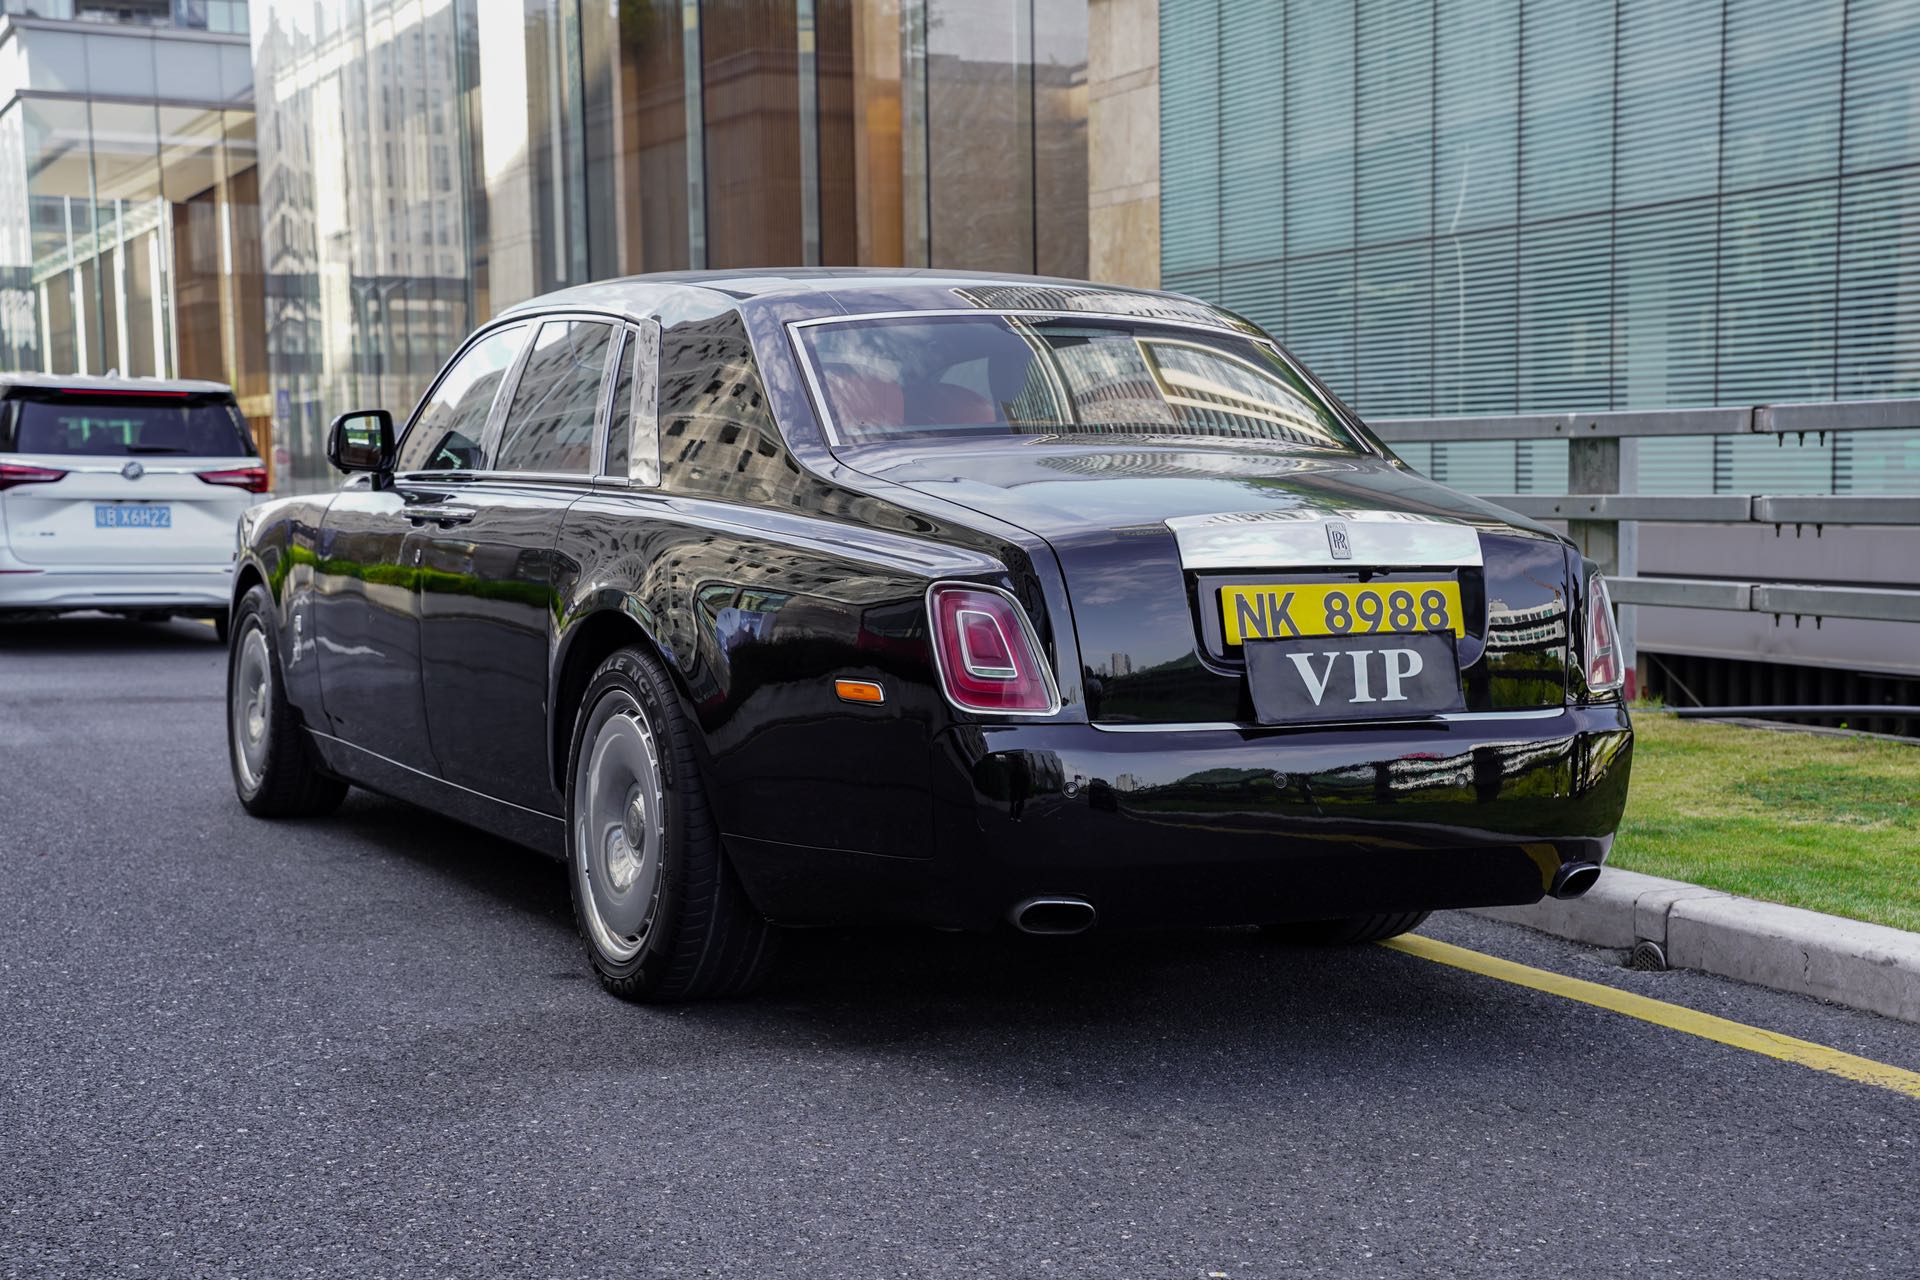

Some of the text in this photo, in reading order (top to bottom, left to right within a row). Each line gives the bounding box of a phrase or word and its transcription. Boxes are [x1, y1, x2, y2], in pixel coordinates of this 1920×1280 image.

[121, 508, 170, 527] X6H22
[1234, 589, 1451, 638] NK 8988
[1285, 648, 1425, 706] VIP
